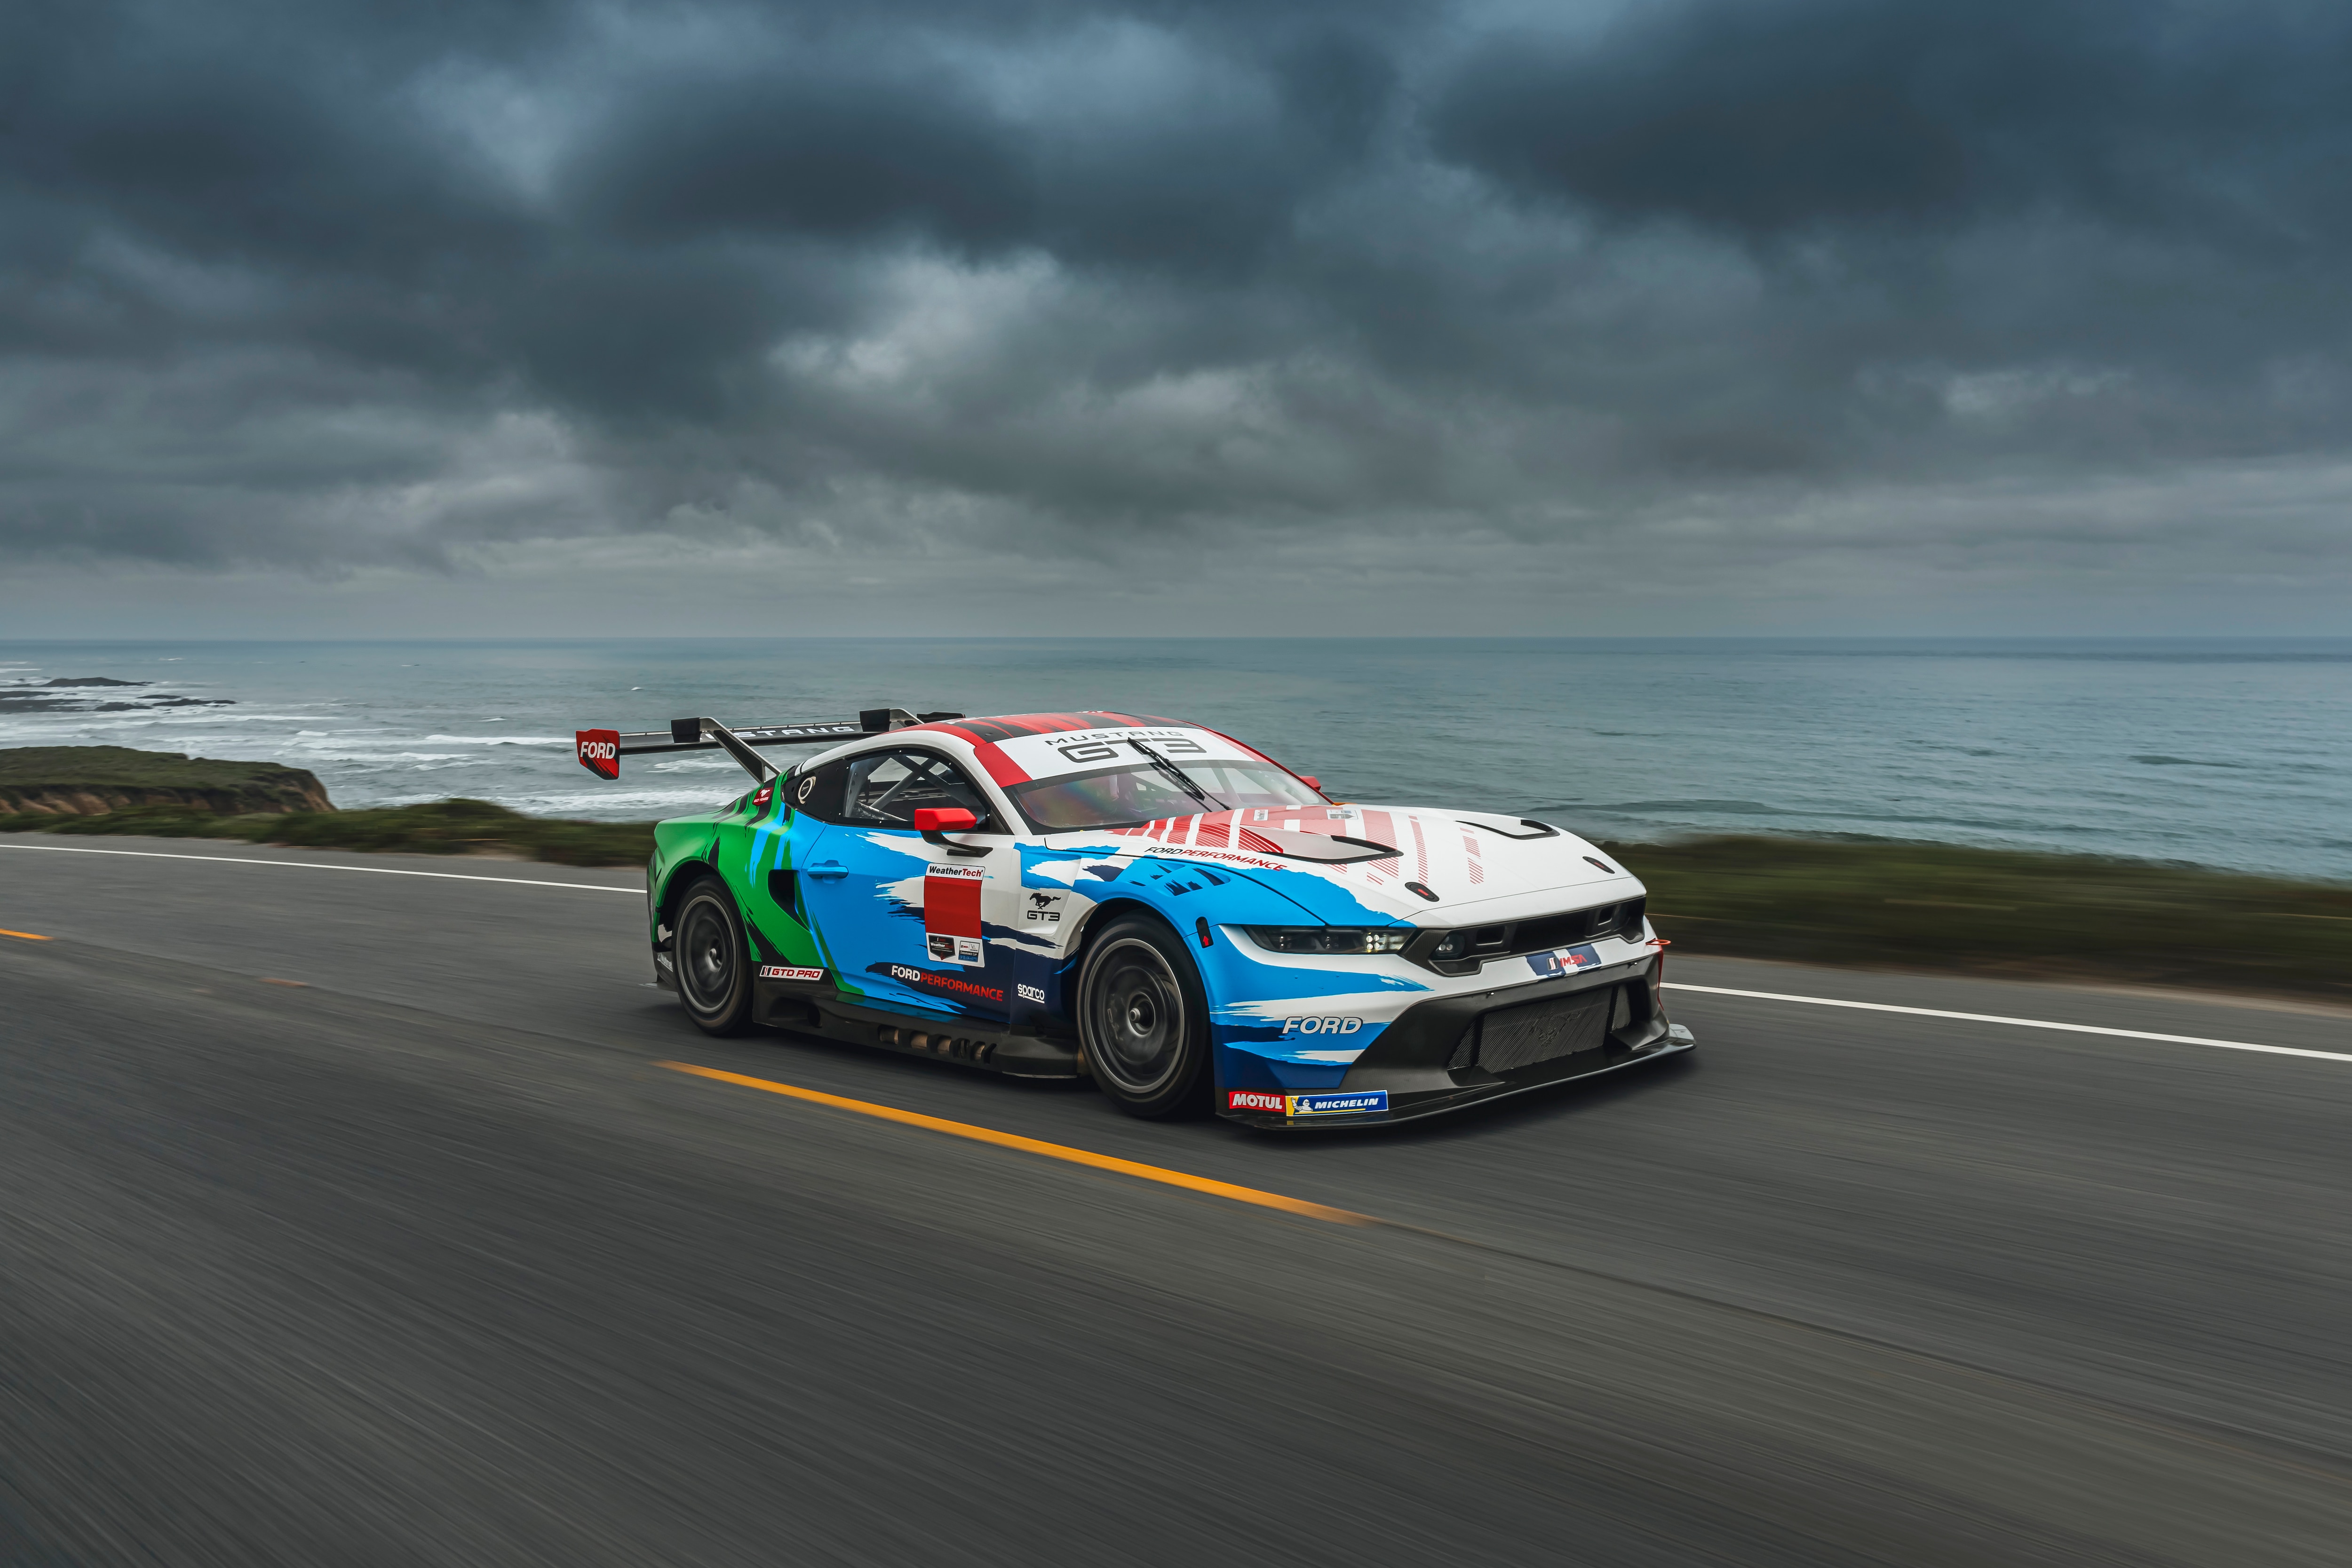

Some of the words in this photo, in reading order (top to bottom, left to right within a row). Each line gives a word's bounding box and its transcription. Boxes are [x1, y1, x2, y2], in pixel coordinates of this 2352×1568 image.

[699, 726, 855, 740] STANG
[1044, 731, 1184, 746] MUSTANG
[580, 741, 616, 759] FORD
[1057, 738, 1207, 763] GT3
[1027, 910, 1060, 922] GT3
[1559, 954, 1588, 968] IMSA
[796, 970, 820, 978] PRO
[1017, 983, 1045, 1001] sparco
[1282, 1016, 1363, 1034] FORD
[1232, 1094, 1282, 1109] MOTUL
[1314, 1098, 1379, 1109] MICHELIN
